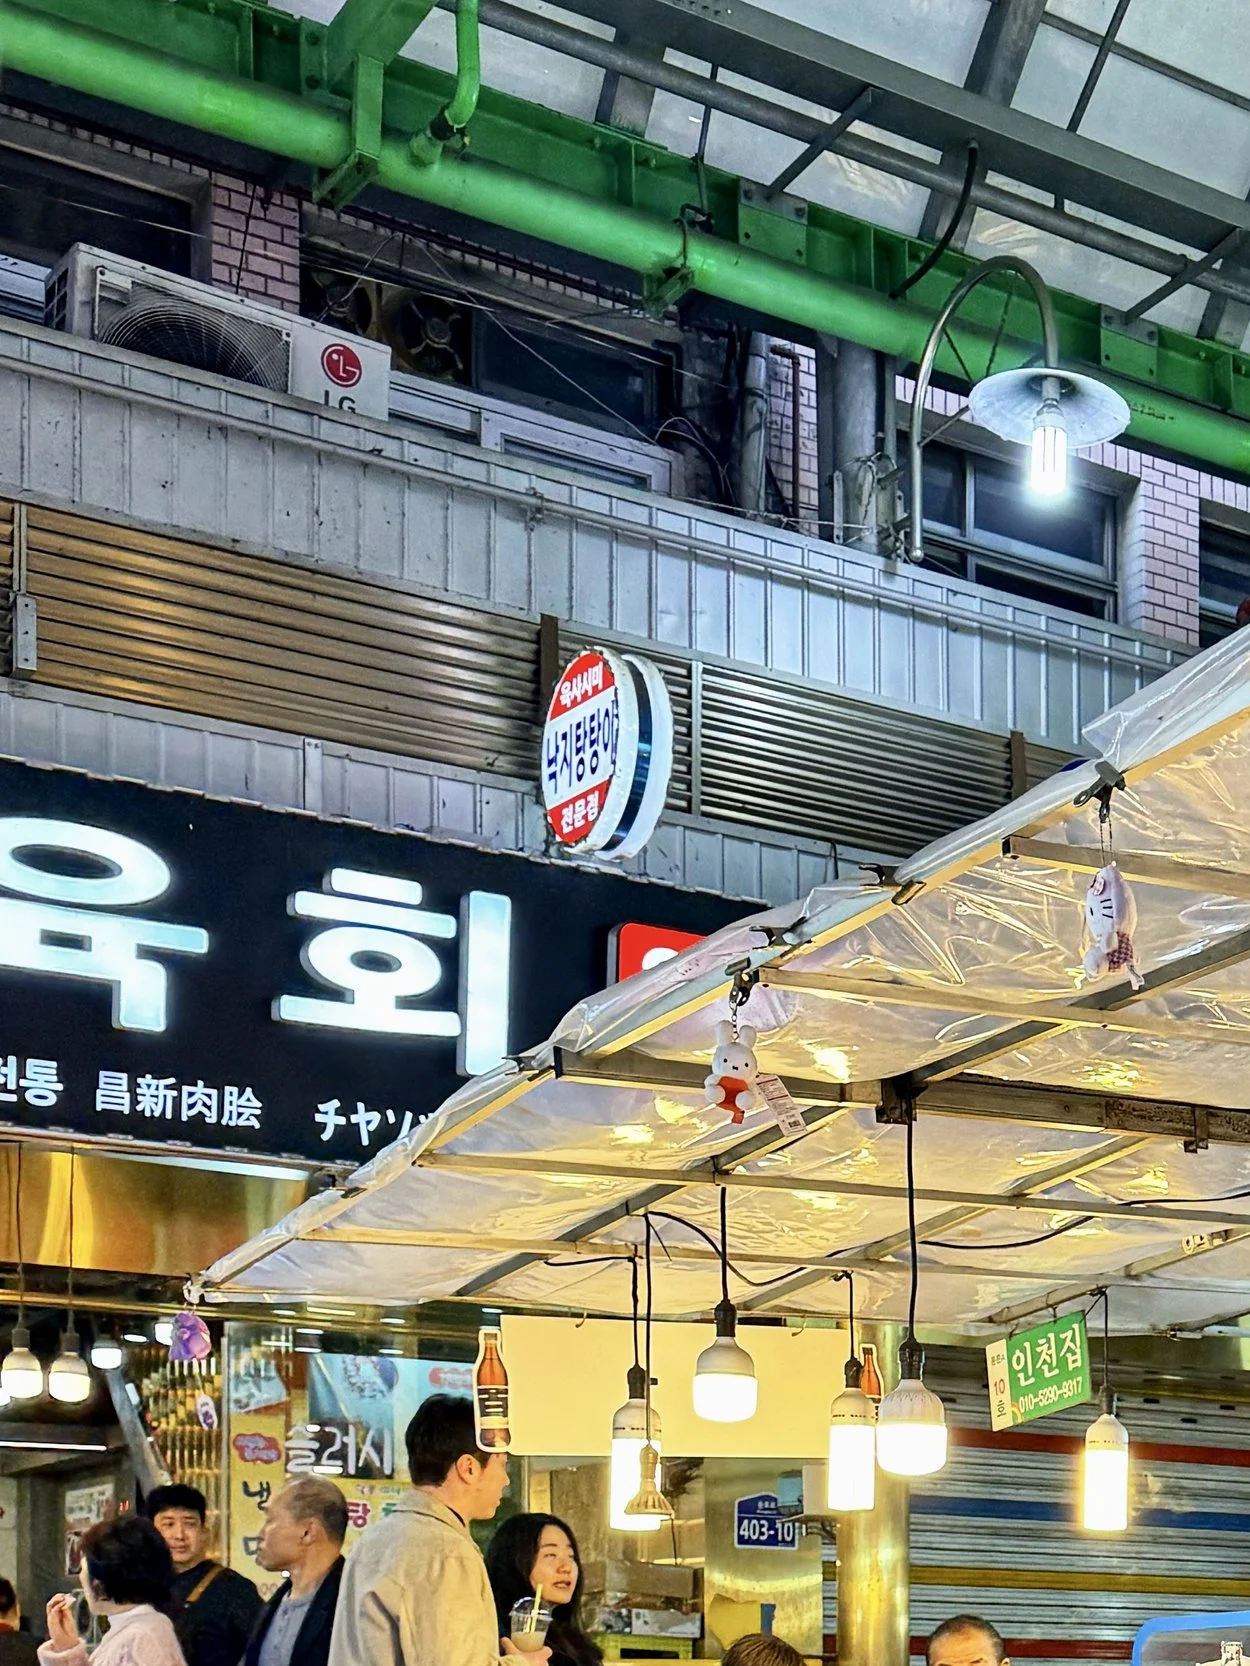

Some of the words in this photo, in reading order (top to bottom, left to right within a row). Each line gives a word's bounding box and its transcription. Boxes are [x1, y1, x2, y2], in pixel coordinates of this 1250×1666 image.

[560, 662, 603, 708] 육사시미
[547, 699, 619, 795] 낙지탕탕이
[561, 791, 600, 834] 전문점
[1012, 1323, 1082, 1387] 인천집
[993, 1378, 1006, 1396] 10
[1019, 1376, 1083, 1414] 010-5290-9317
[996, 1400, 1007, 1418] 호
[284, 1423, 393, 1476] 슬러시
[739, 1519, 794, 1542] 403-10
